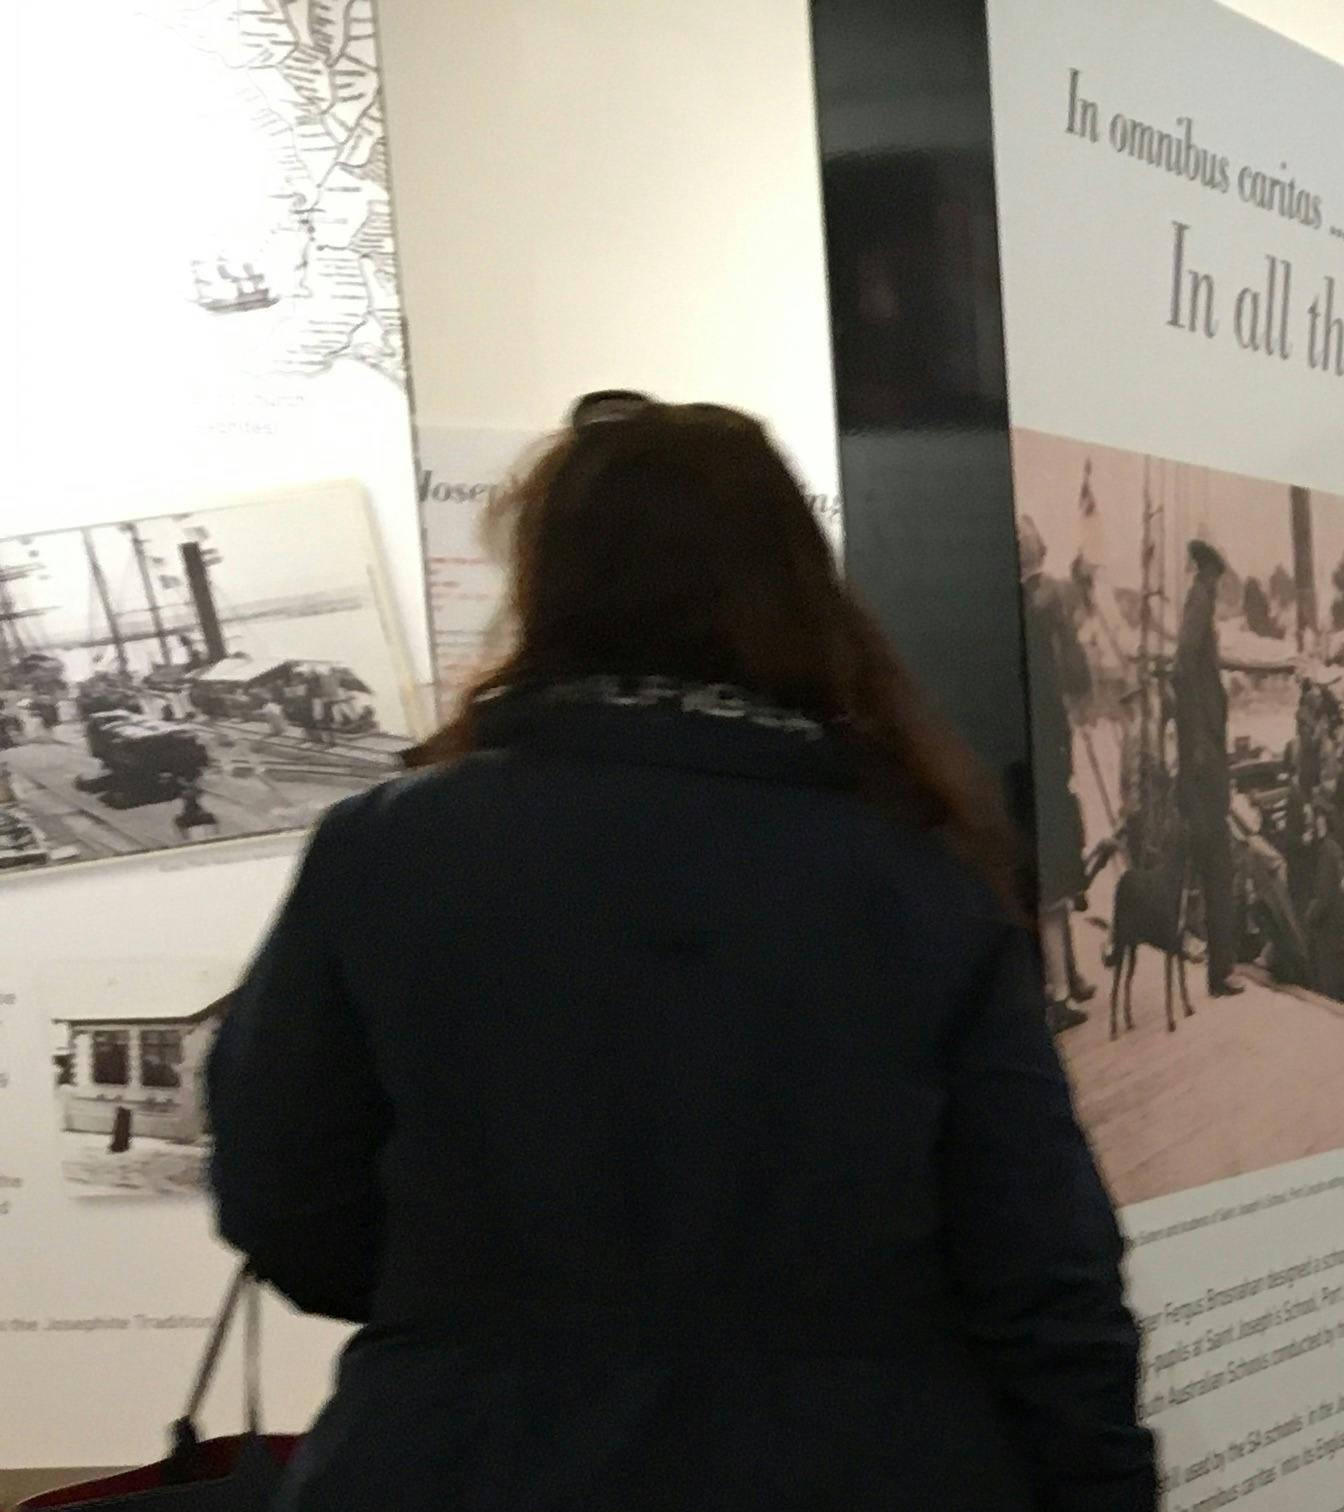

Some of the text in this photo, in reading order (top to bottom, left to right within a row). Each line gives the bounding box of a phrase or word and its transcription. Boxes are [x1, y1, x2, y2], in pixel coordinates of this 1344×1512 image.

[1065, 67, 1099, 144] In
[1109, 115, 1230, 195] omnibus
[1237, 160, 1323, 231] caritas
[1166, 219, 1218, 339] In
[1233, 253, 1293, 361] all
